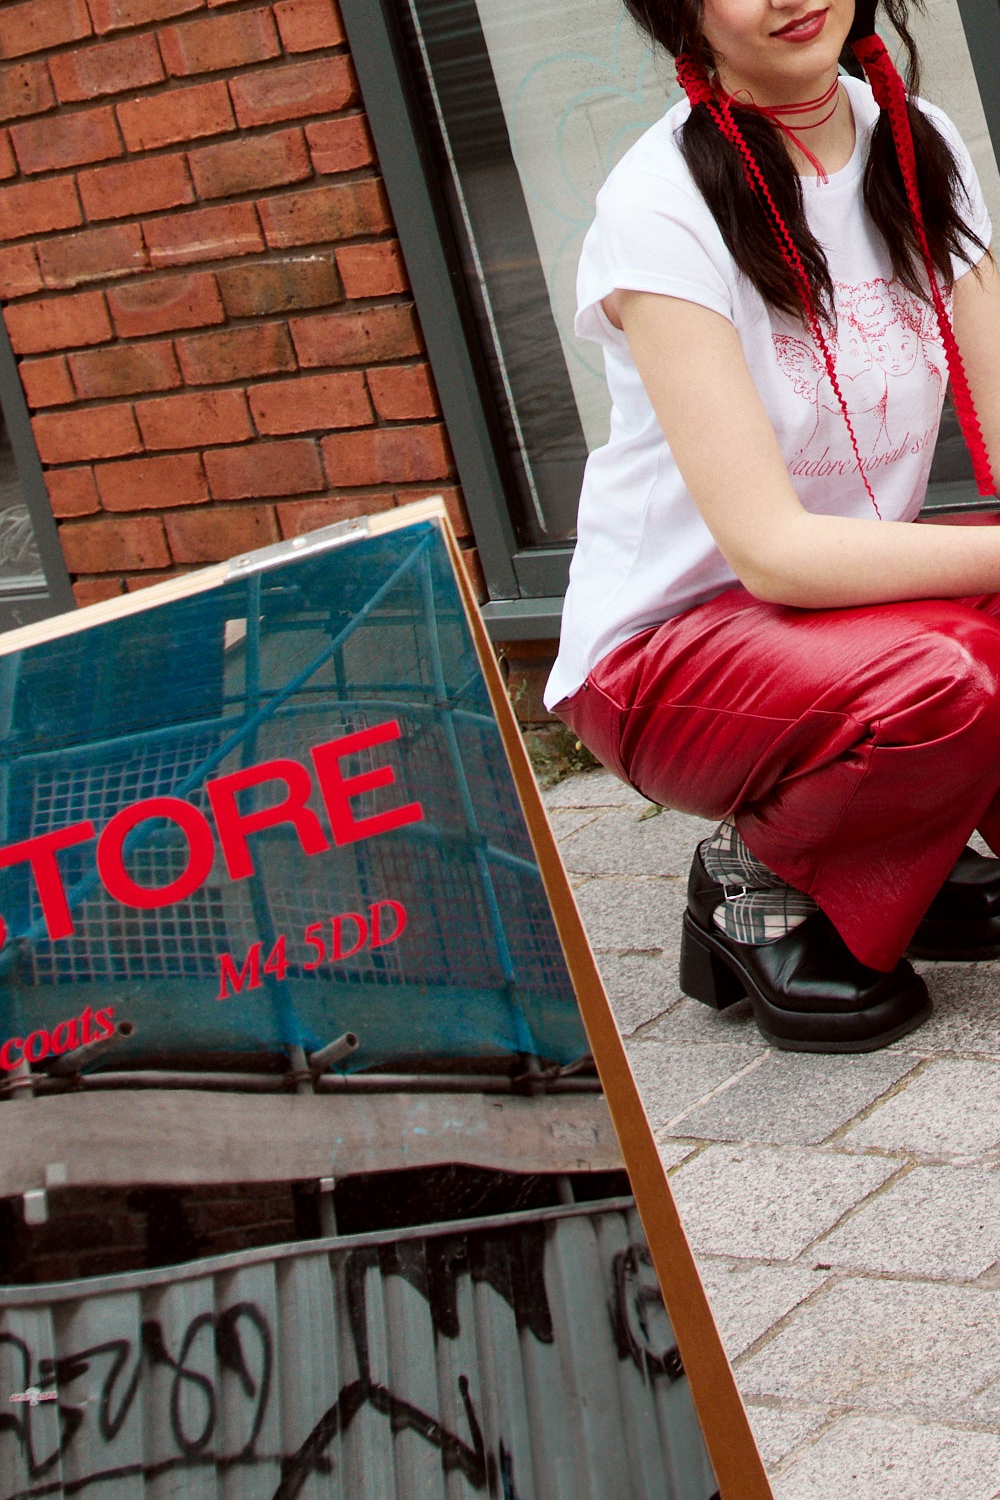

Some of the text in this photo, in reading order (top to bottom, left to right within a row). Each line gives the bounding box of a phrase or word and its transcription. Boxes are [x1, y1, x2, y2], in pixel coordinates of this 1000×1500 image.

[0, 719, 424, 953] TORE
[216, 900, 408, 1001] M4 5DD
[0, 1004, 116, 1072] coats
